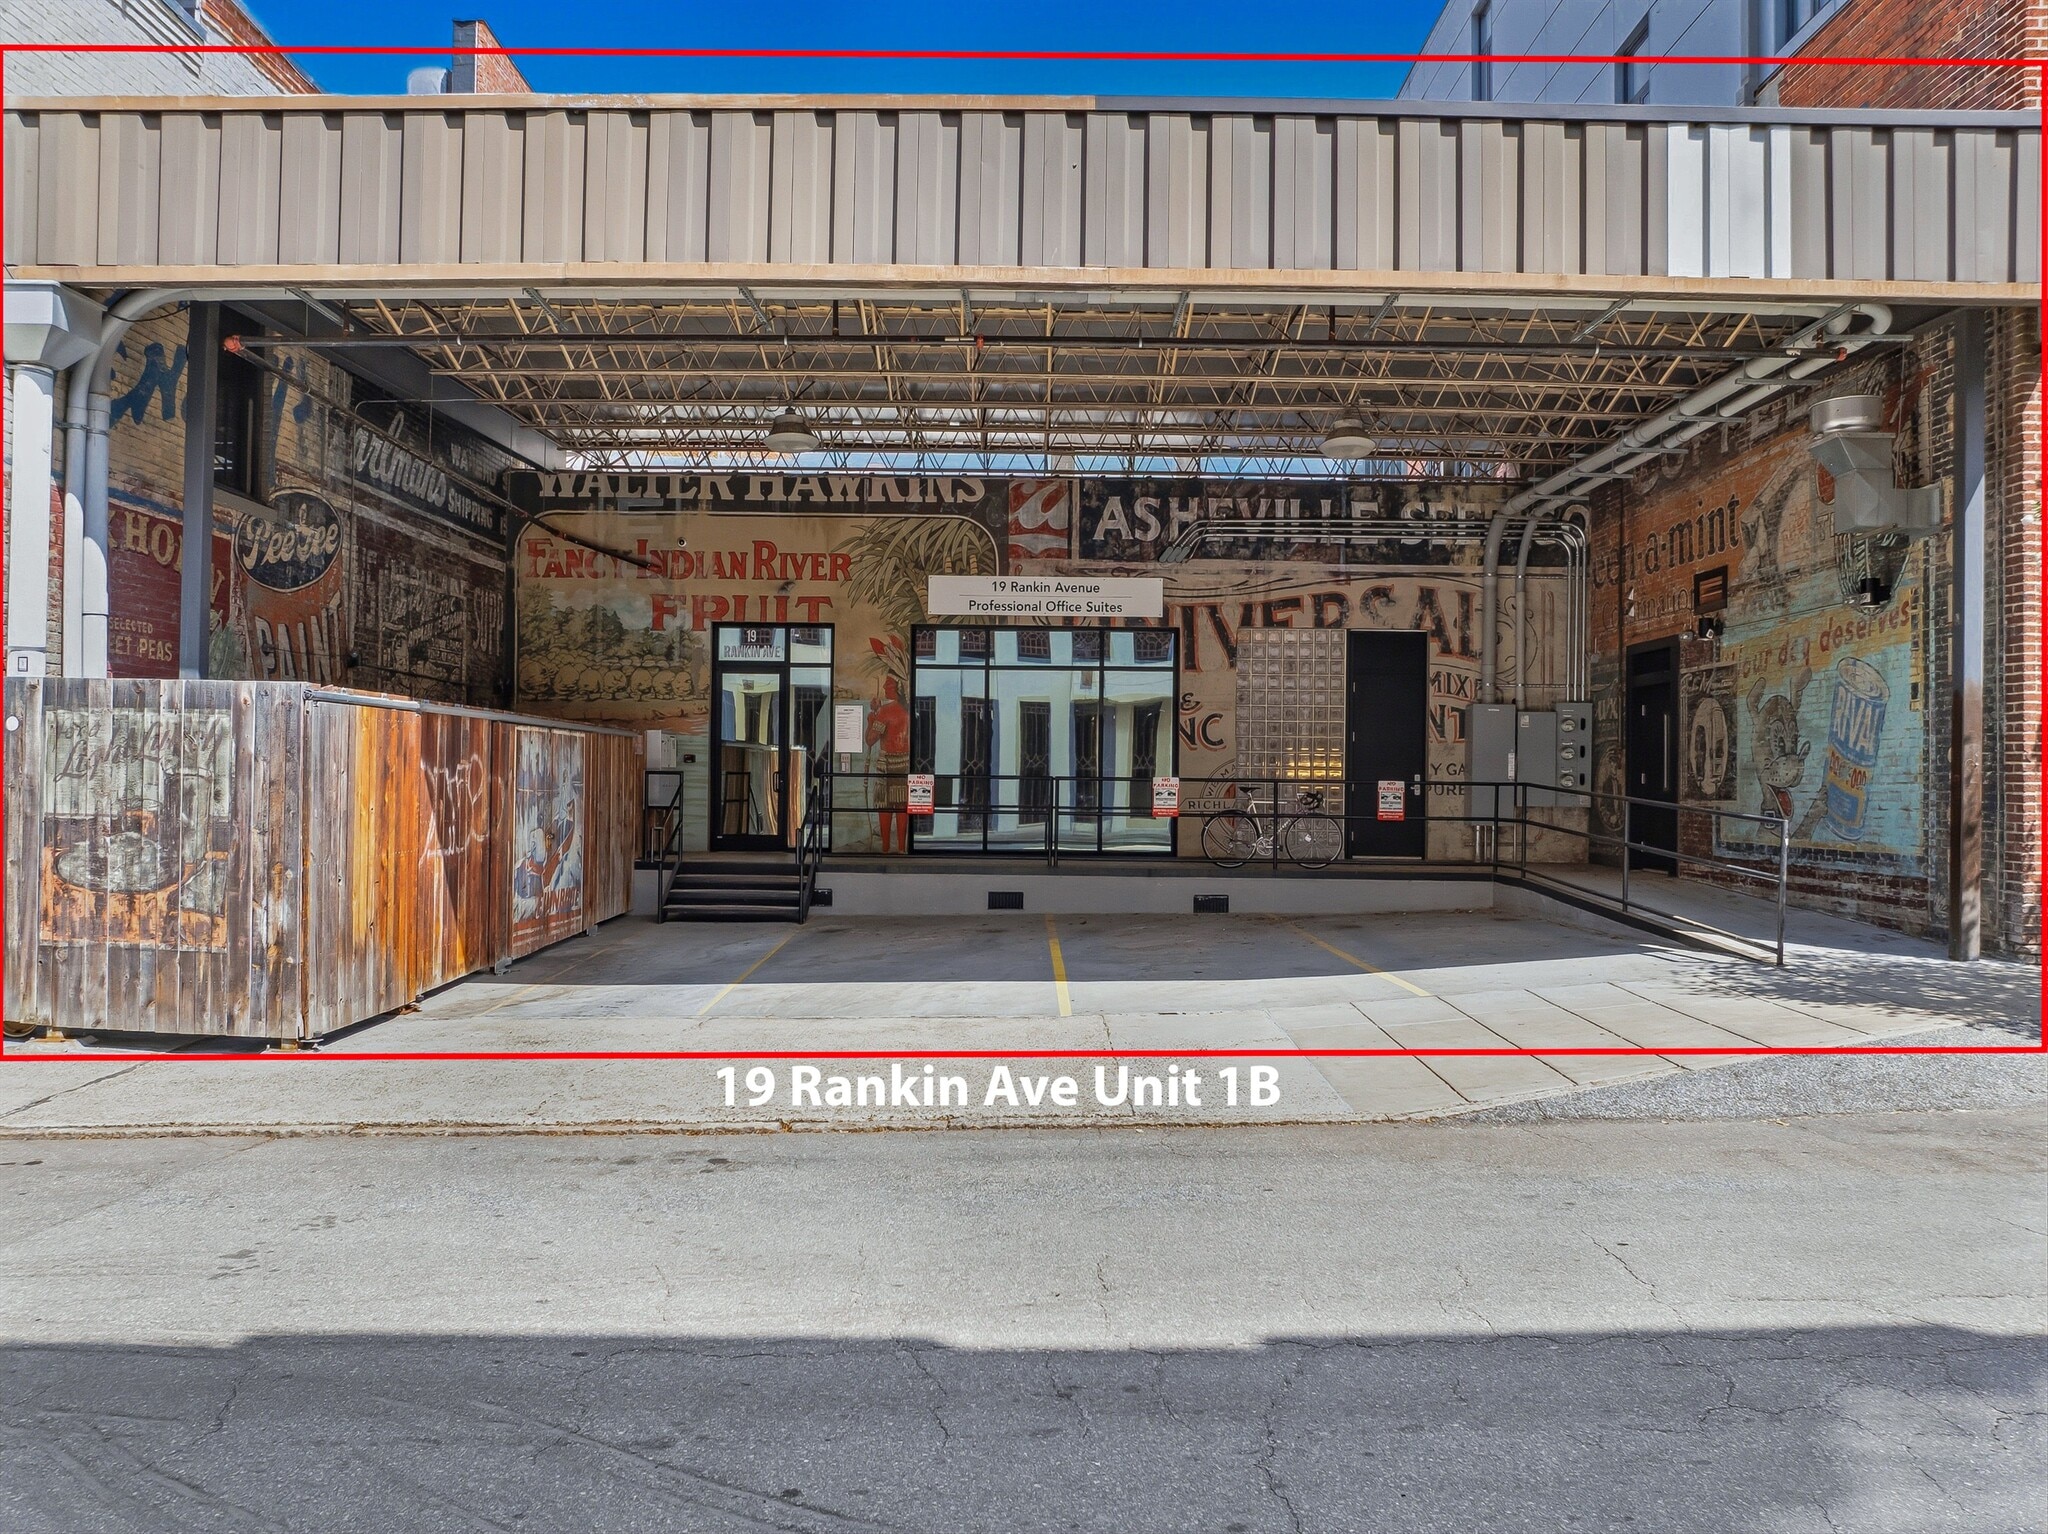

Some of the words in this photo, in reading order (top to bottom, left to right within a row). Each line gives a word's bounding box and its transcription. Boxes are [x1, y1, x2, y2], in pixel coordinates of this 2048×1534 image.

[635, 539, 748, 580] INDIAN
[751, 540, 853, 581] RIVER
[992, 581, 1007, 593] 19
[1011, 581, 1051, 593] Rankin
[1055, 582, 1100, 593] Avenue
[968, 600, 1042, 613] Professional
[1046, 601, 1082, 612] Office
[1086, 602, 1123, 613] Suites
[746, 629, 757, 642] 19
[138, 638, 173, 662] PEAS
[723, 645, 760, 658] RANKIN
[763, 645, 781, 658] AVE
